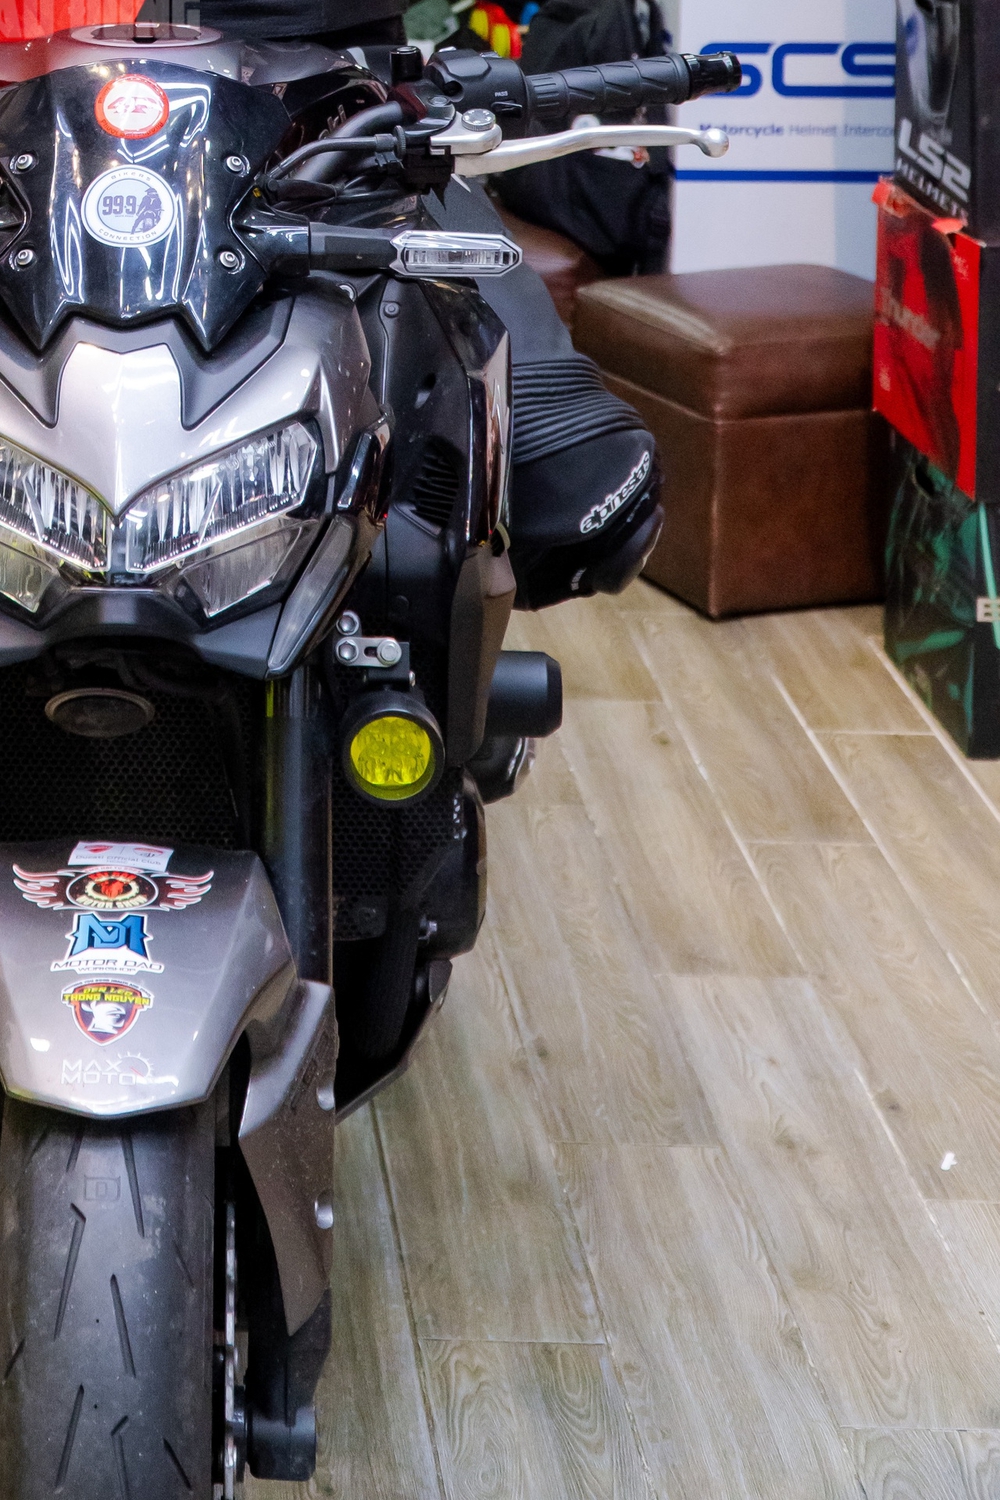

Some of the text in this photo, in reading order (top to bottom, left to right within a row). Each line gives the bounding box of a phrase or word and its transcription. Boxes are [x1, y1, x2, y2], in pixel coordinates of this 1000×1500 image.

[699, 42, 896, 97] SCS
[700, 123, 895, 138] Mtorcycle Helmet Interco
[898, 118, 971, 203] LS2
[110, 171, 151, 182] BIKERS
[98, 228, 157, 242] CONNECTION
[53, 958, 118, 970] MOTOR
[62, 1059, 123, 1073] MAX
[60, 1071, 137, 1086] MOTO
